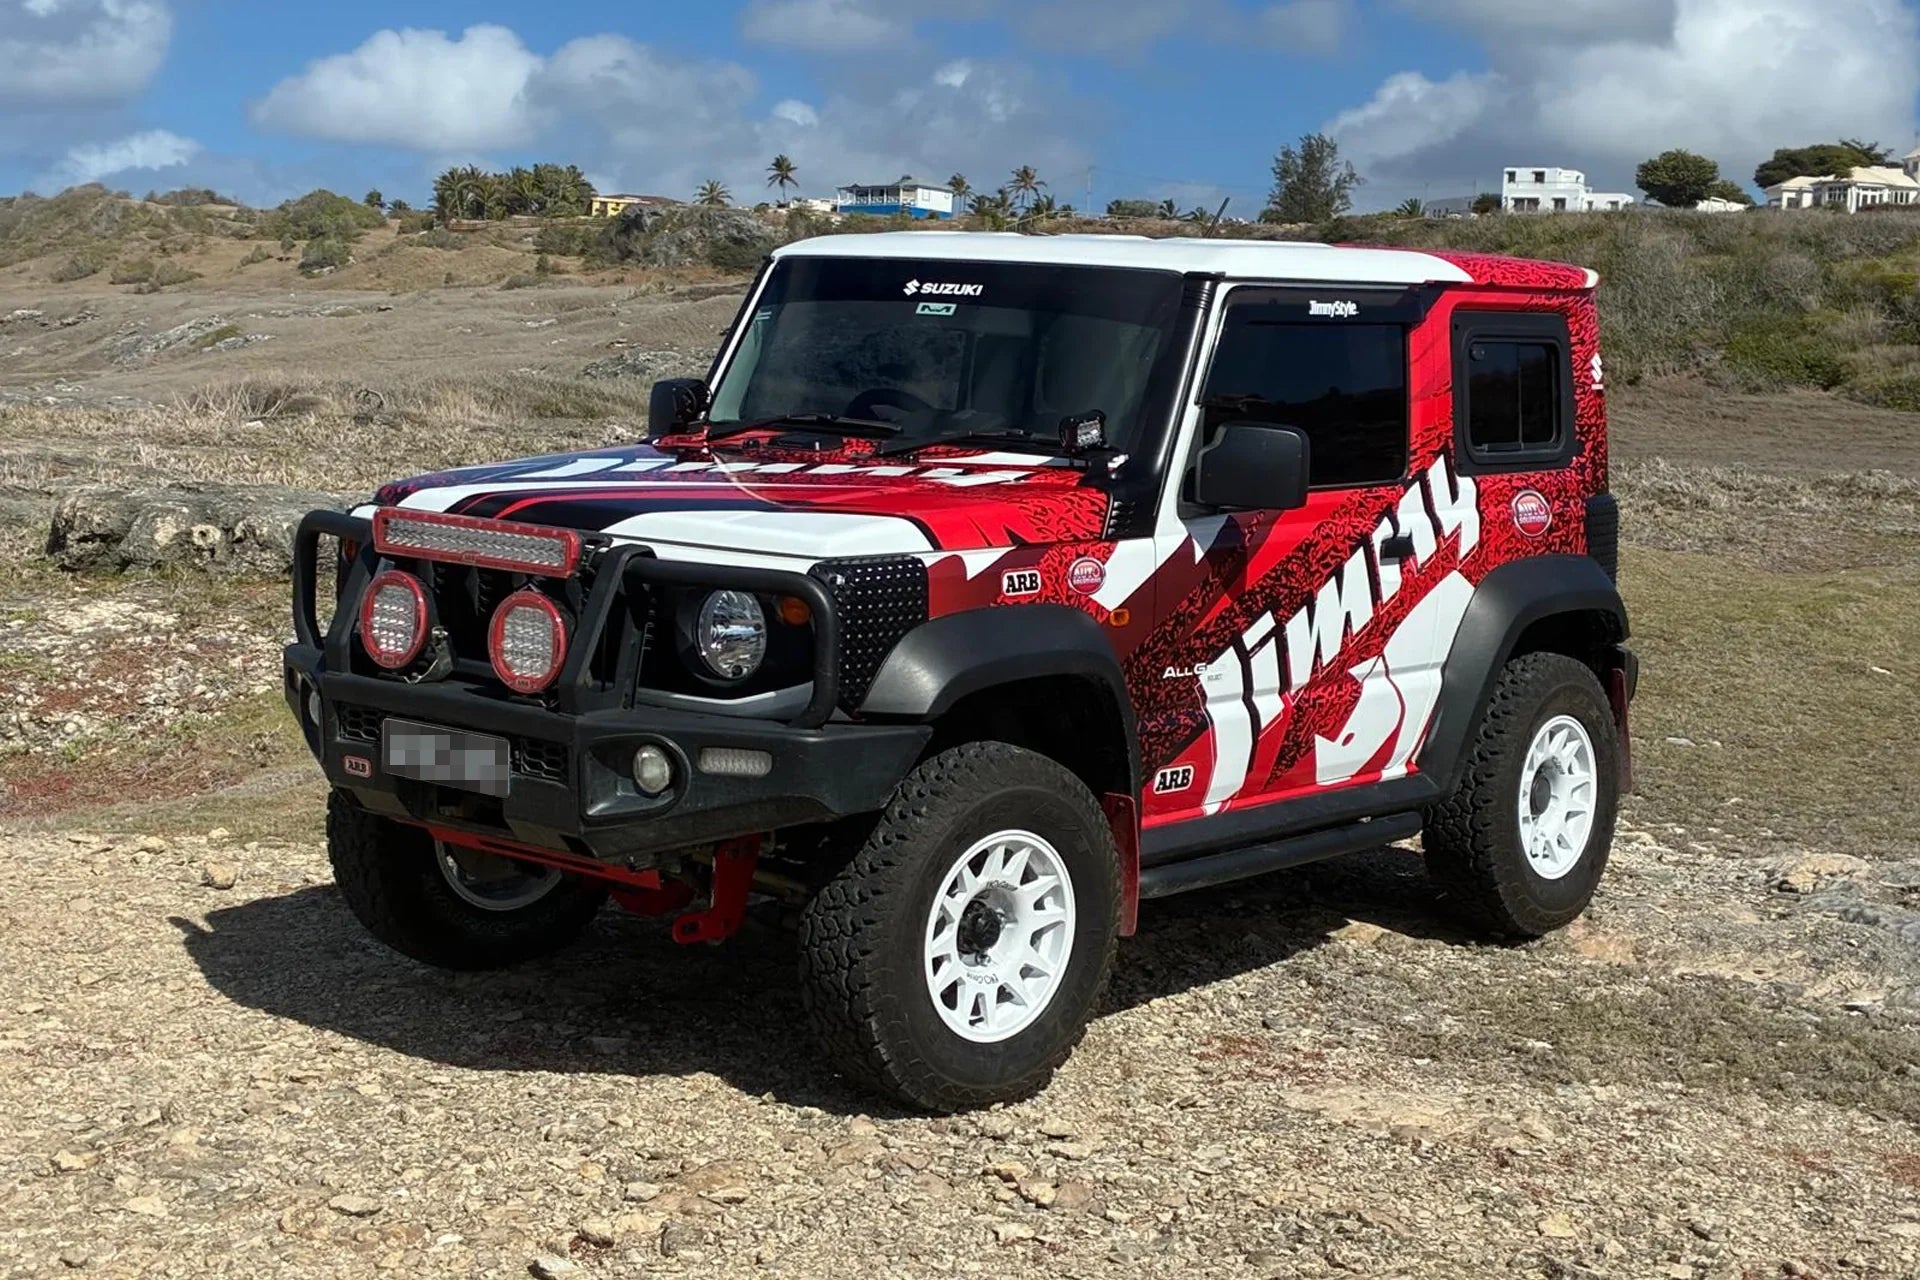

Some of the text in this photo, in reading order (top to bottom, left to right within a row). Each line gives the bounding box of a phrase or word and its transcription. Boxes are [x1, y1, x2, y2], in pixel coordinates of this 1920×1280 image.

[920, 283, 983, 296] SUZUKI
[1005, 573, 1039, 593] ARB
[1155, 768, 1191, 792] ARB
